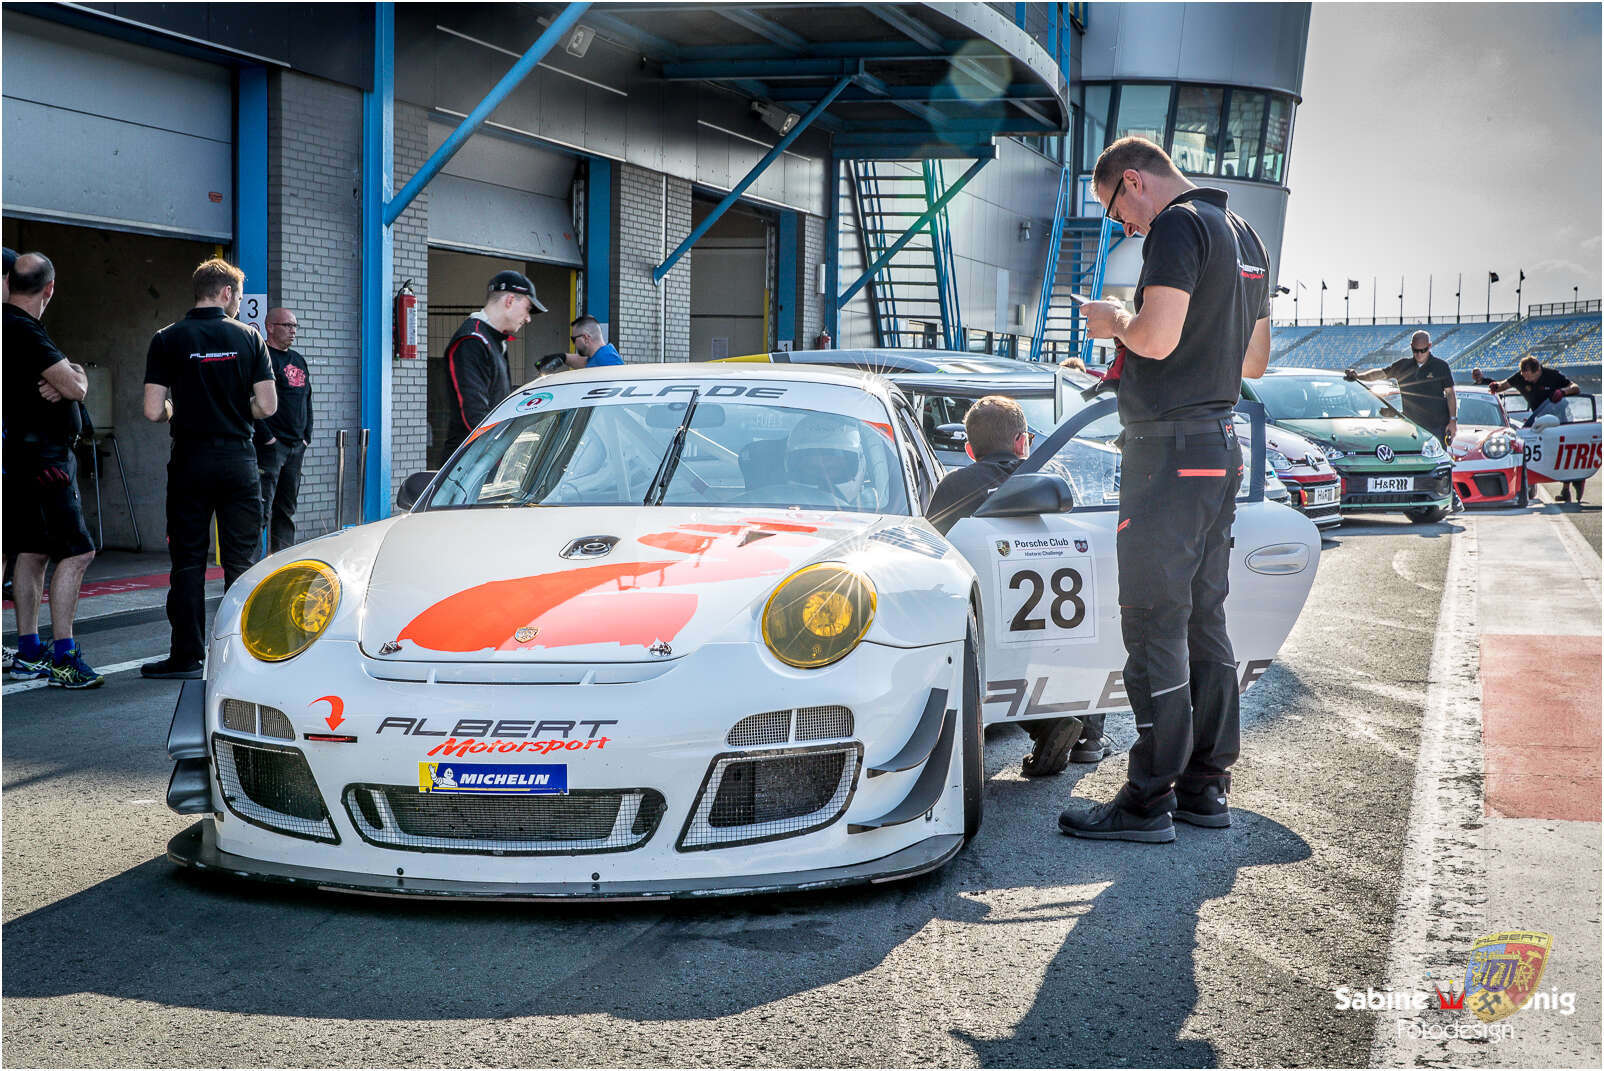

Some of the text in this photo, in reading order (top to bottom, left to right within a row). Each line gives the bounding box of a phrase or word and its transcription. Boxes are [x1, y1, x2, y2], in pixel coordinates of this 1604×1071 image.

[248, 299, 258, 319] 3
[1014, 538, 1069, 548] Porsche Club
[1009, 567, 1086, 631] 28
[376, 716, 619, 738] ALBERT
[427, 736, 612, 758] Motorsport
[459, 773, 550, 786] MICHELIN
